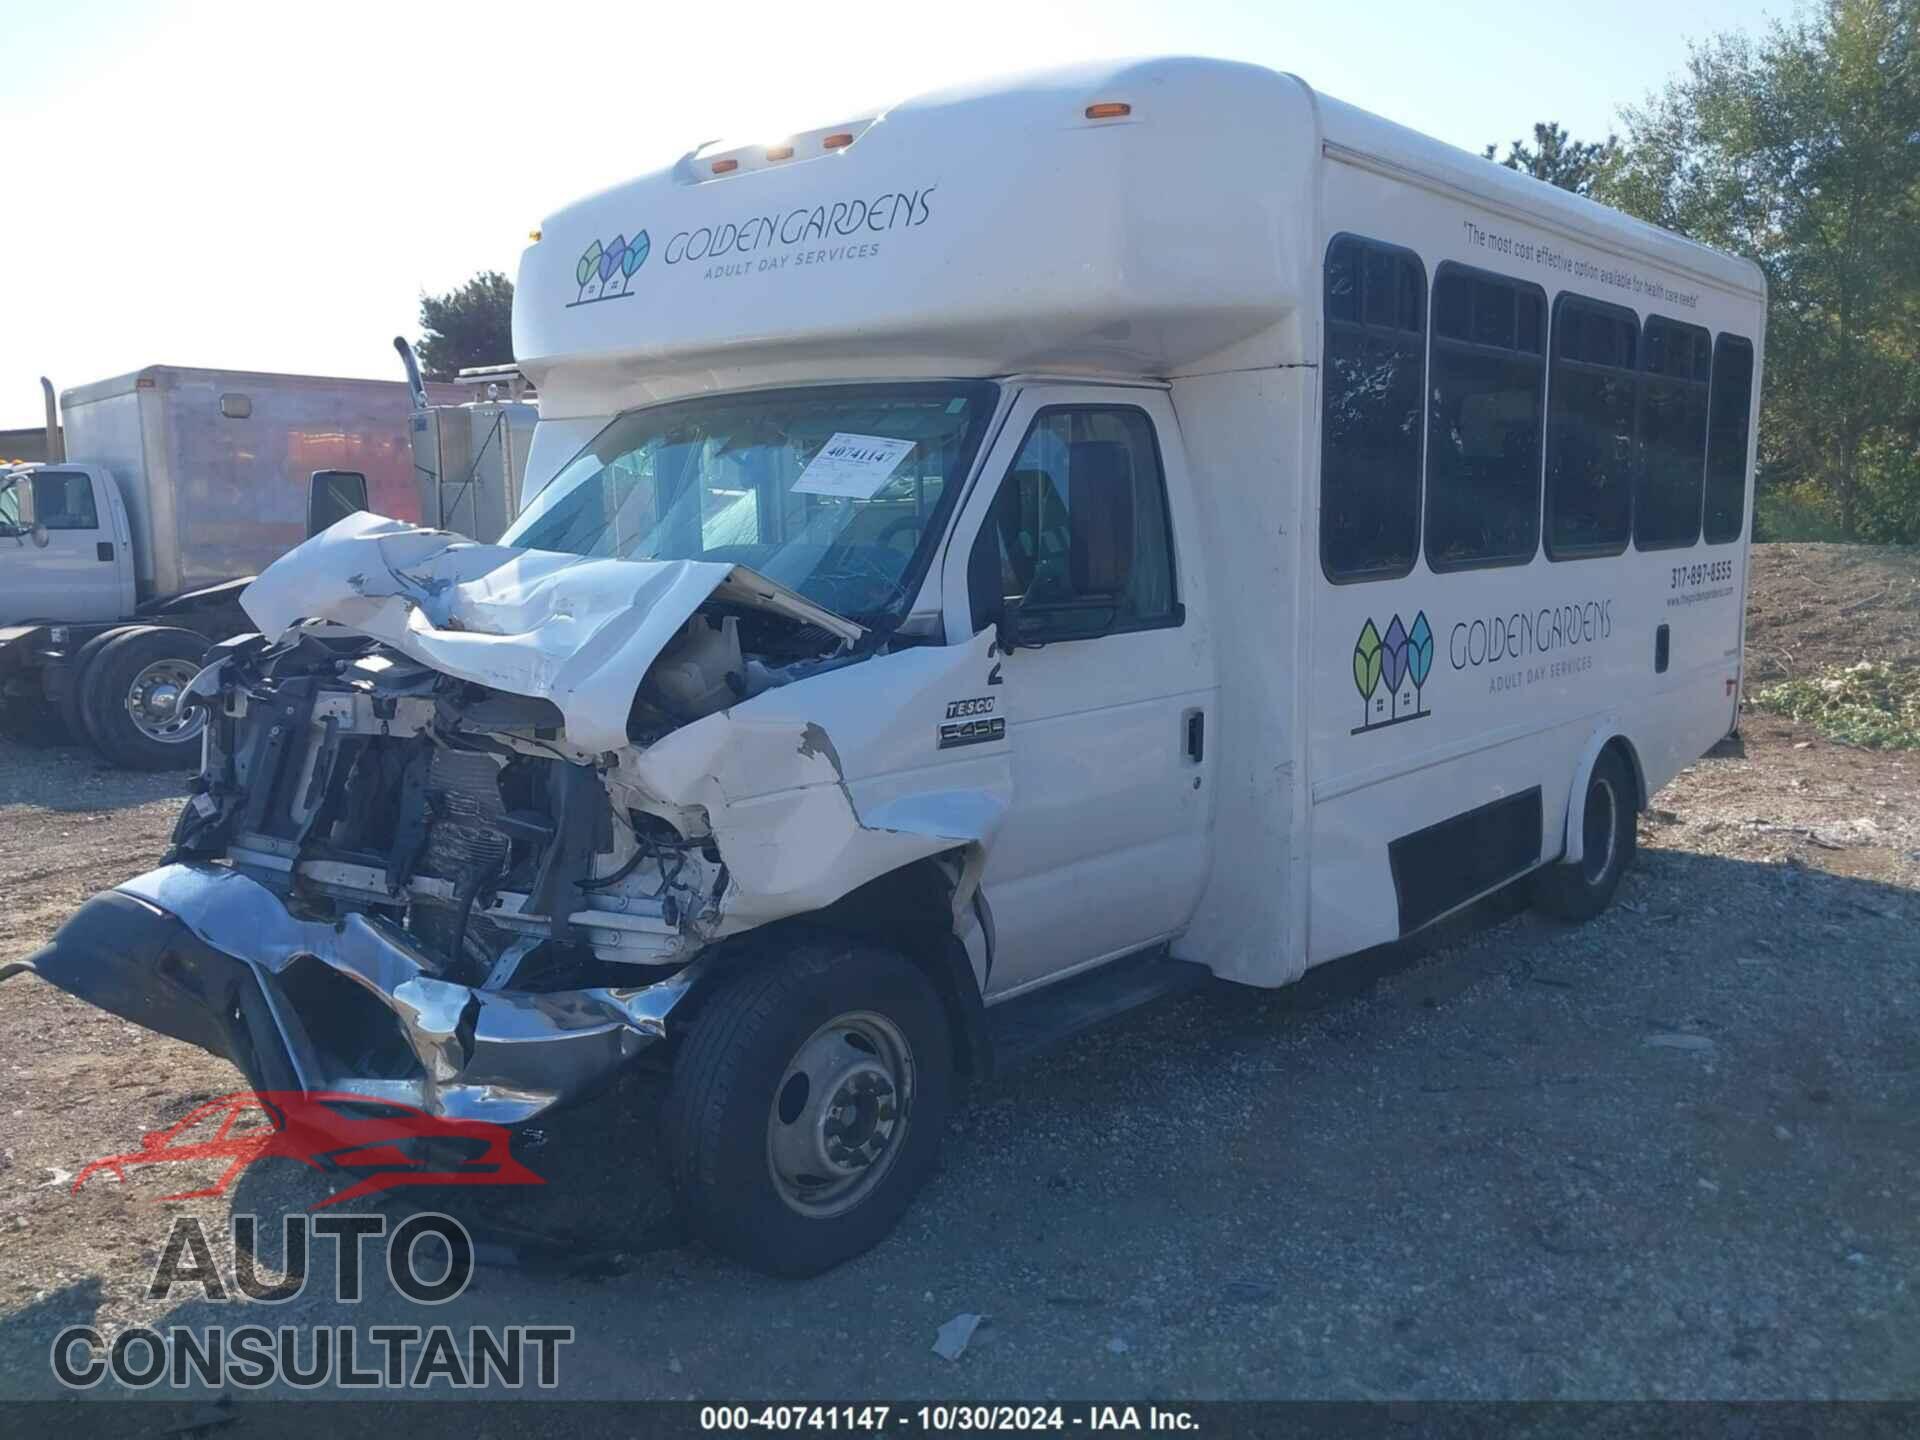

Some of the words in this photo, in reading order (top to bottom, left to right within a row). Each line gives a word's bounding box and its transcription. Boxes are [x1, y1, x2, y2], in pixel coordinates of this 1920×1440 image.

[703, 261, 753, 281] ADULT
[758, 255, 789, 273] DAY
[794, 243, 881, 267] SERVICES
[1488, 233, 1513, 256] most
[1514, 242, 1535, 261] cost
[1536, 246, 1573, 273] effective
[1574, 261, 1600, 281] option
[1600, 268, 1632, 291] available
[1632, 274, 1644, 293] for
[1644, 280, 1664, 299] health
[826, 446, 897, 463] 40741147
[1671, 559, 1732, 589] 317-897-8555
[1488, 671, 1523, 695] ADULT
[1526, 666, 1547, 685] DAY
[1549, 655, 1593, 679] SERVICES
[946, 696, 995, 719] TESCO
